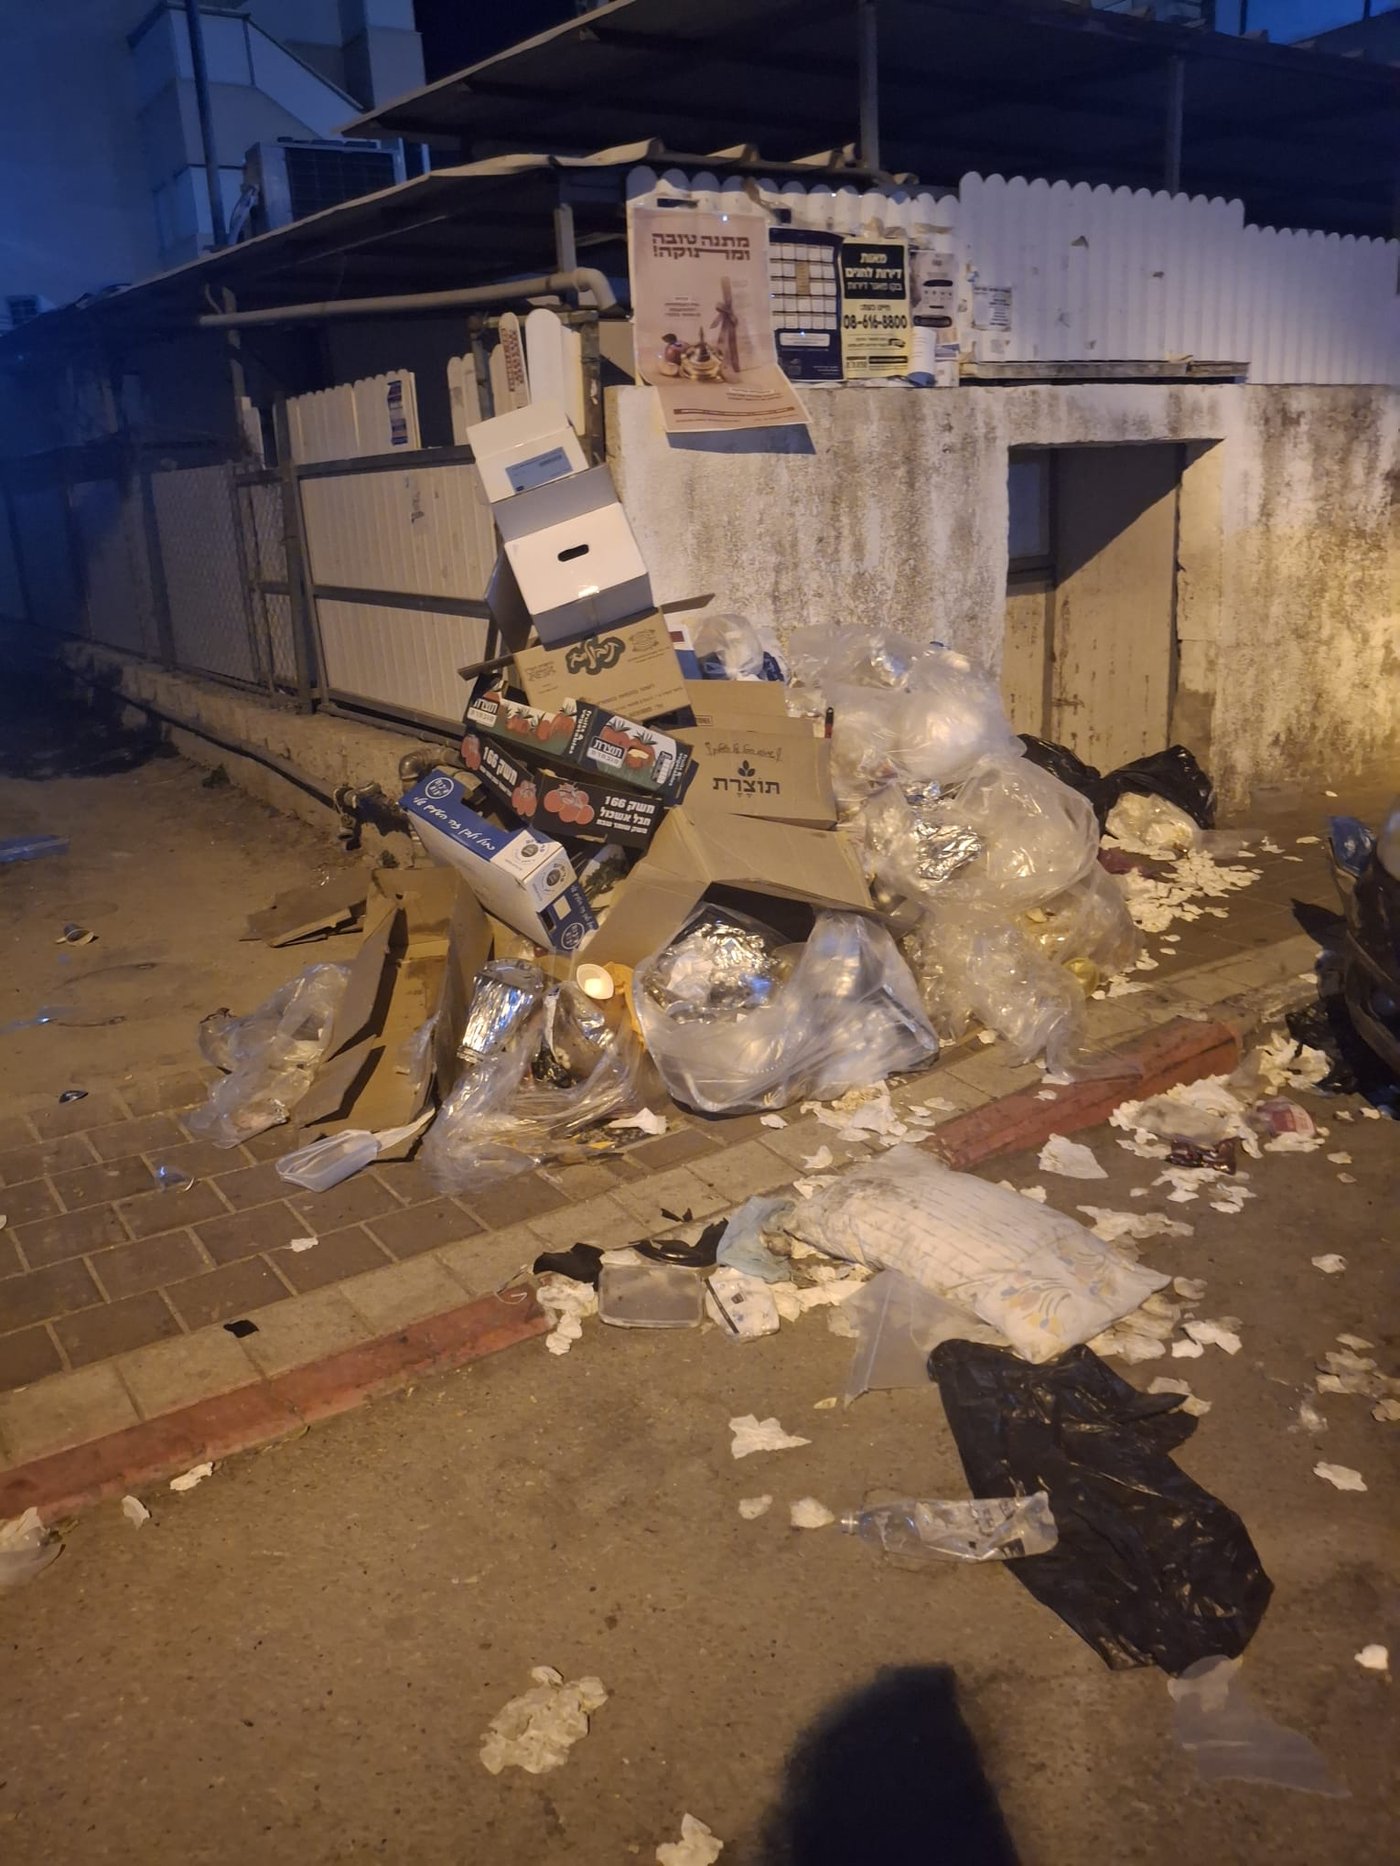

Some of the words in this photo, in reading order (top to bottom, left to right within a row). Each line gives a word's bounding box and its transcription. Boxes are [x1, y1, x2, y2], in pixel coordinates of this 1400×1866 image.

[652, 233, 698, 245] טובה
[701, 235, 750, 248] מתנה
[843, 314, 908, 329] 08-616-8800
[593, 738, 623, 759] תוצרת
[605, 796, 626, 809] 166
[627, 800, 656, 815] משק
[600, 806, 633, 823] אשכול
[633, 812, 651, 826] חבל
